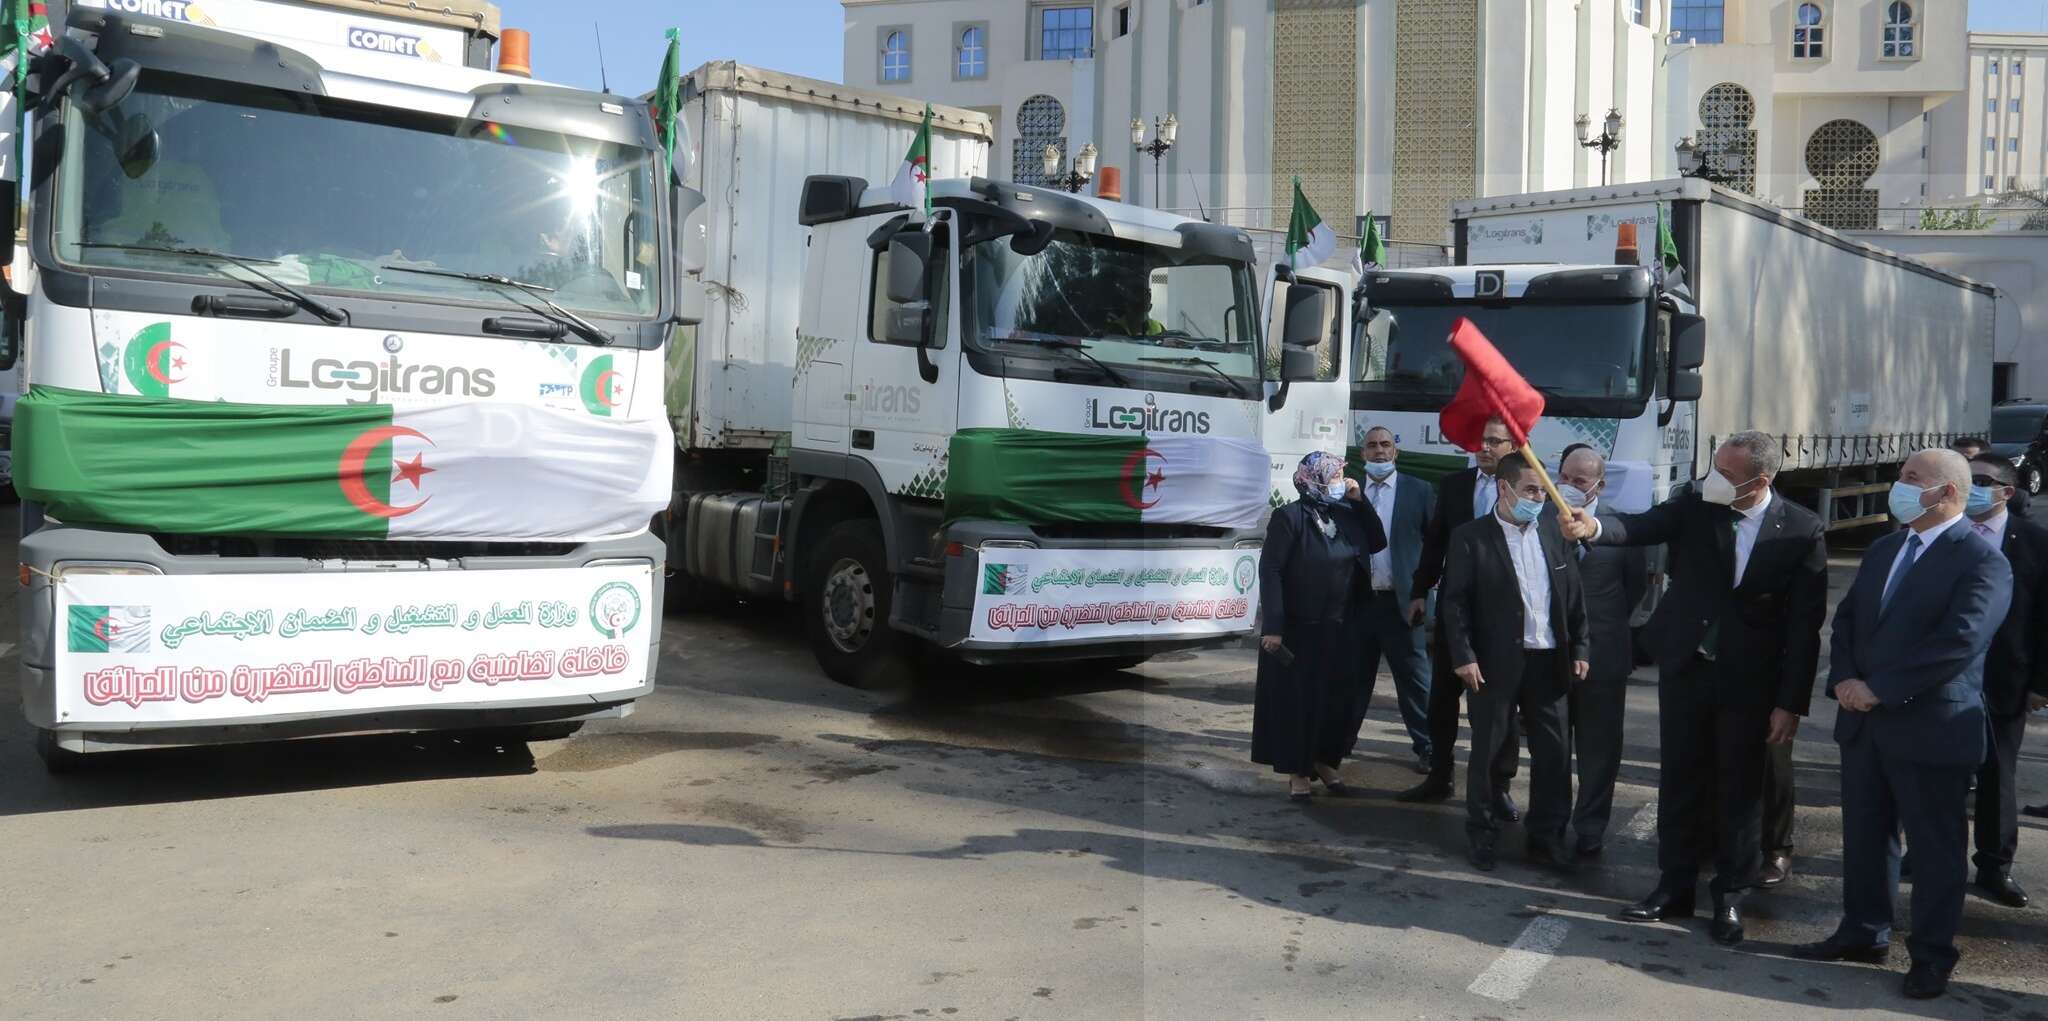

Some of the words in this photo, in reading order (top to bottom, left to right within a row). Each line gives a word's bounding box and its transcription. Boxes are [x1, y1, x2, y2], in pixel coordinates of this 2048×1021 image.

[350, 27, 418, 56] COMET
[1476, 273, 1500, 296] D
[266, 347, 279, 388] Groupe
[280, 348, 496, 405] Logitrans
[1092, 398, 1210, 436] Logitrans
[160, 608, 273, 650] الاجتماعي
[279, 606, 358, 638] الضمان
[361, 612, 381, 635] و
[384, 602, 457, 634] التشغيل
[461, 609, 481, 629] و
[483, 600, 533, 629] العمل
[538, 599, 580, 628] وزارة
[333, 655, 428, 694] المناطق
[429, 659, 464, 692] مع
[467, 650, 556, 686] تضامنية
[558, 644, 630, 678] قافلة
[84, 665, 178, 709] الحرائق
[180, 667, 227, 704] من
[231, 660, 333, 703] المتضررة
